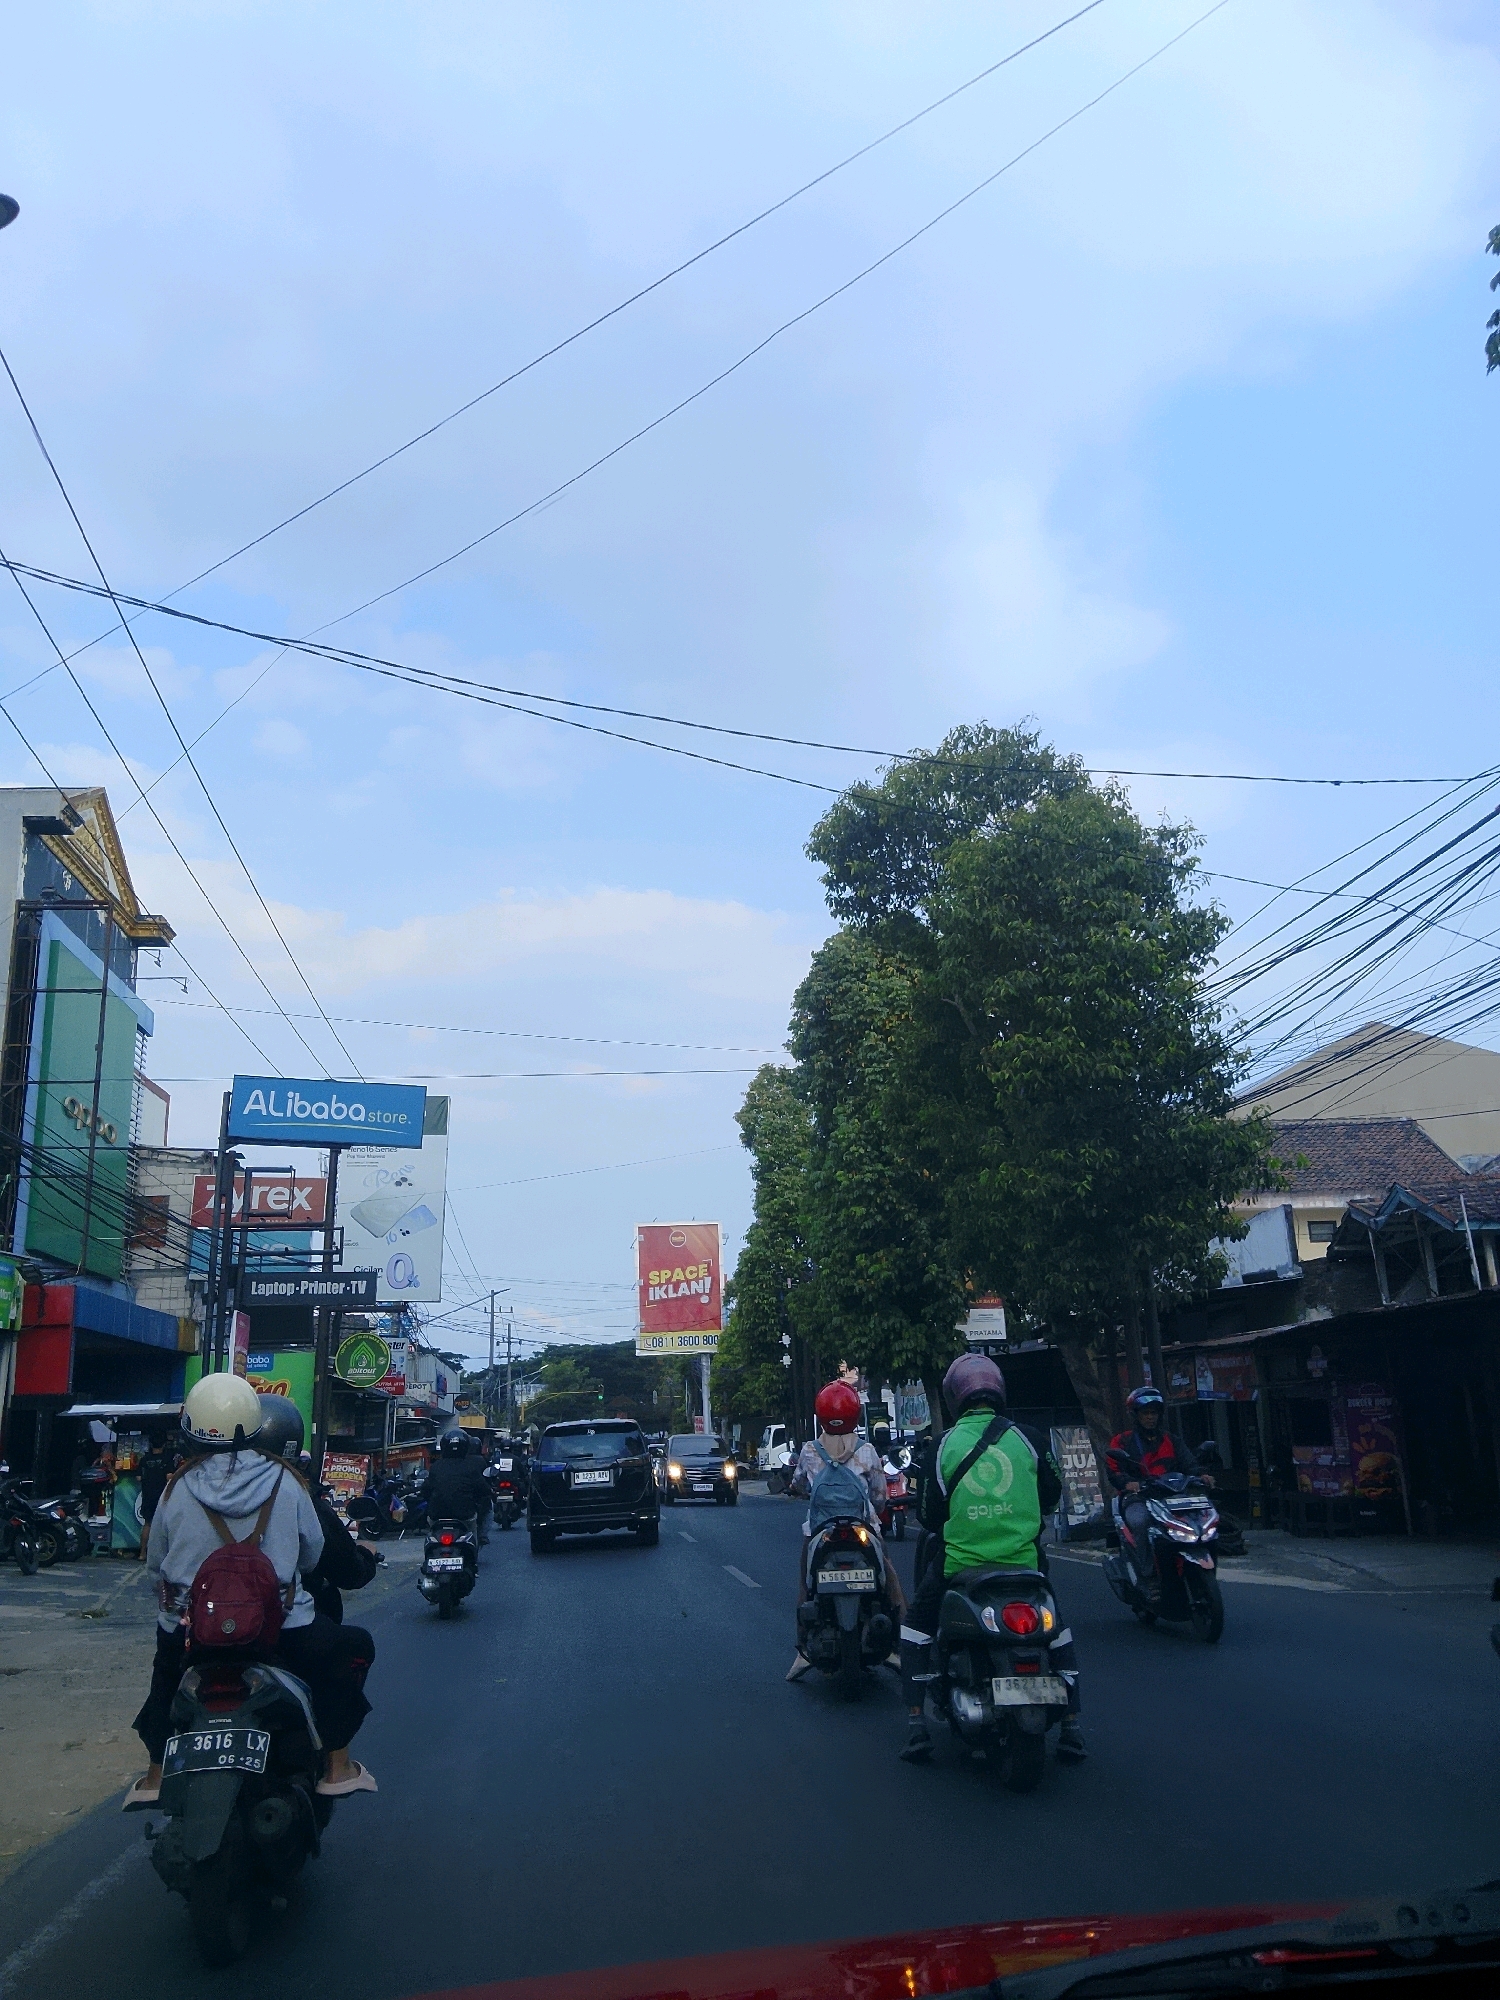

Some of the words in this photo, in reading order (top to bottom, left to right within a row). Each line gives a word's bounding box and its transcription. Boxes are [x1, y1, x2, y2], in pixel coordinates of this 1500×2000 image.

[648, 1263, 708, 1285] SPACE
[648, 1277, 712, 1304] IKLAN!
[651, 1336, 674, 1348] 0811
[677, 1335, 699, 1347] 3600
[325, 1471, 364, 1482] MERDEKA
[330, 1464, 361, 1474] PROMO
[966, 1501, 1013, 1521] gojek
[168, 1739, 178, 1756] N
[193, 1733, 233, 1751] 3616
[246, 1733, 267, 1752] LX
